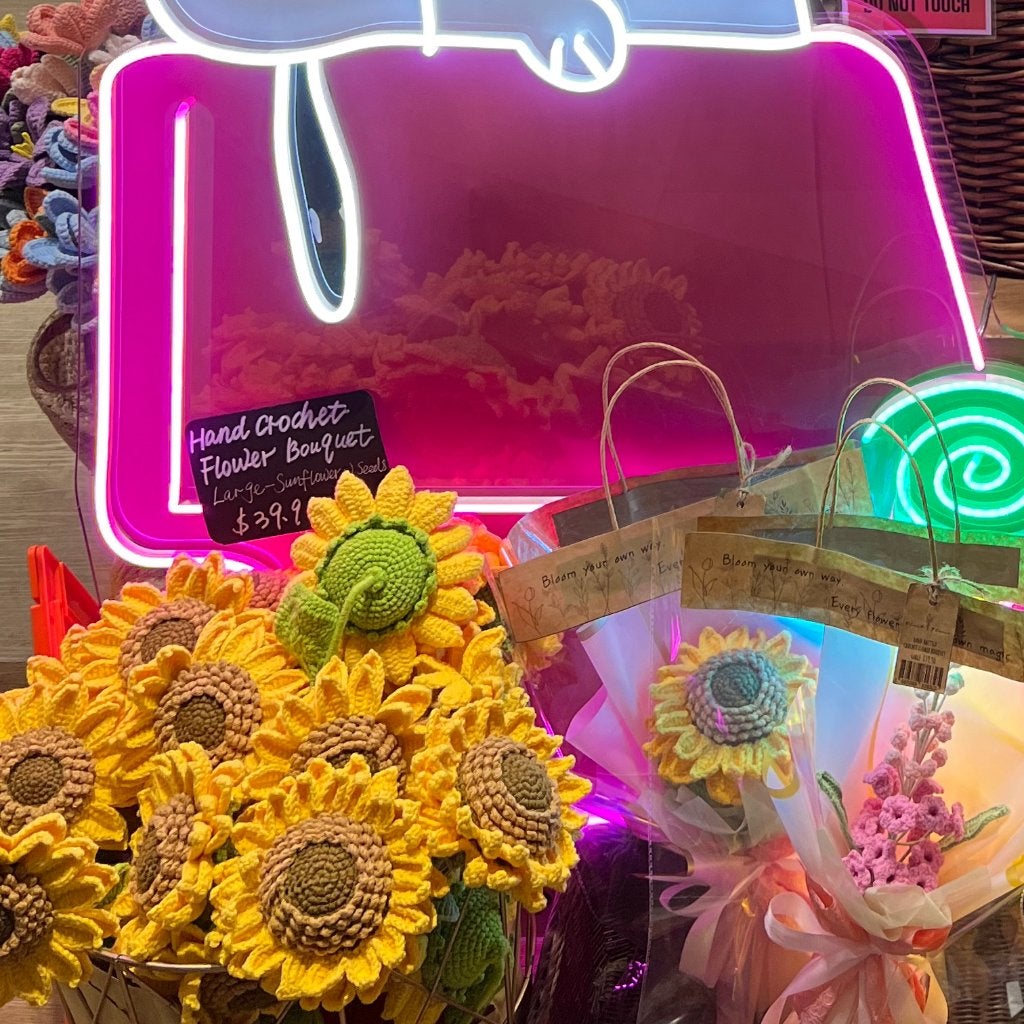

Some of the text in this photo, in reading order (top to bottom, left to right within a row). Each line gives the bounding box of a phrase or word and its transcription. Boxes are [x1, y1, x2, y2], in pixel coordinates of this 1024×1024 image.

[189, 401, 350, 453] Hand Crochet
[200, 424, 374, 485] Flower Bouquet
[357, 458, 388, 472] Seeds
[232, 499, 301, 536] $39.9
[542, 570, 576, 588] Bloom
[583, 560, 609, 577] your
[615, 551, 634, 563] own
[658, 560, 683, 574] Ever
[722, 554, 757, 569] Bloom
[764, 560, 788, 573] your
[794, 569, 815, 578] own
[831, 596, 860, 617] Every
